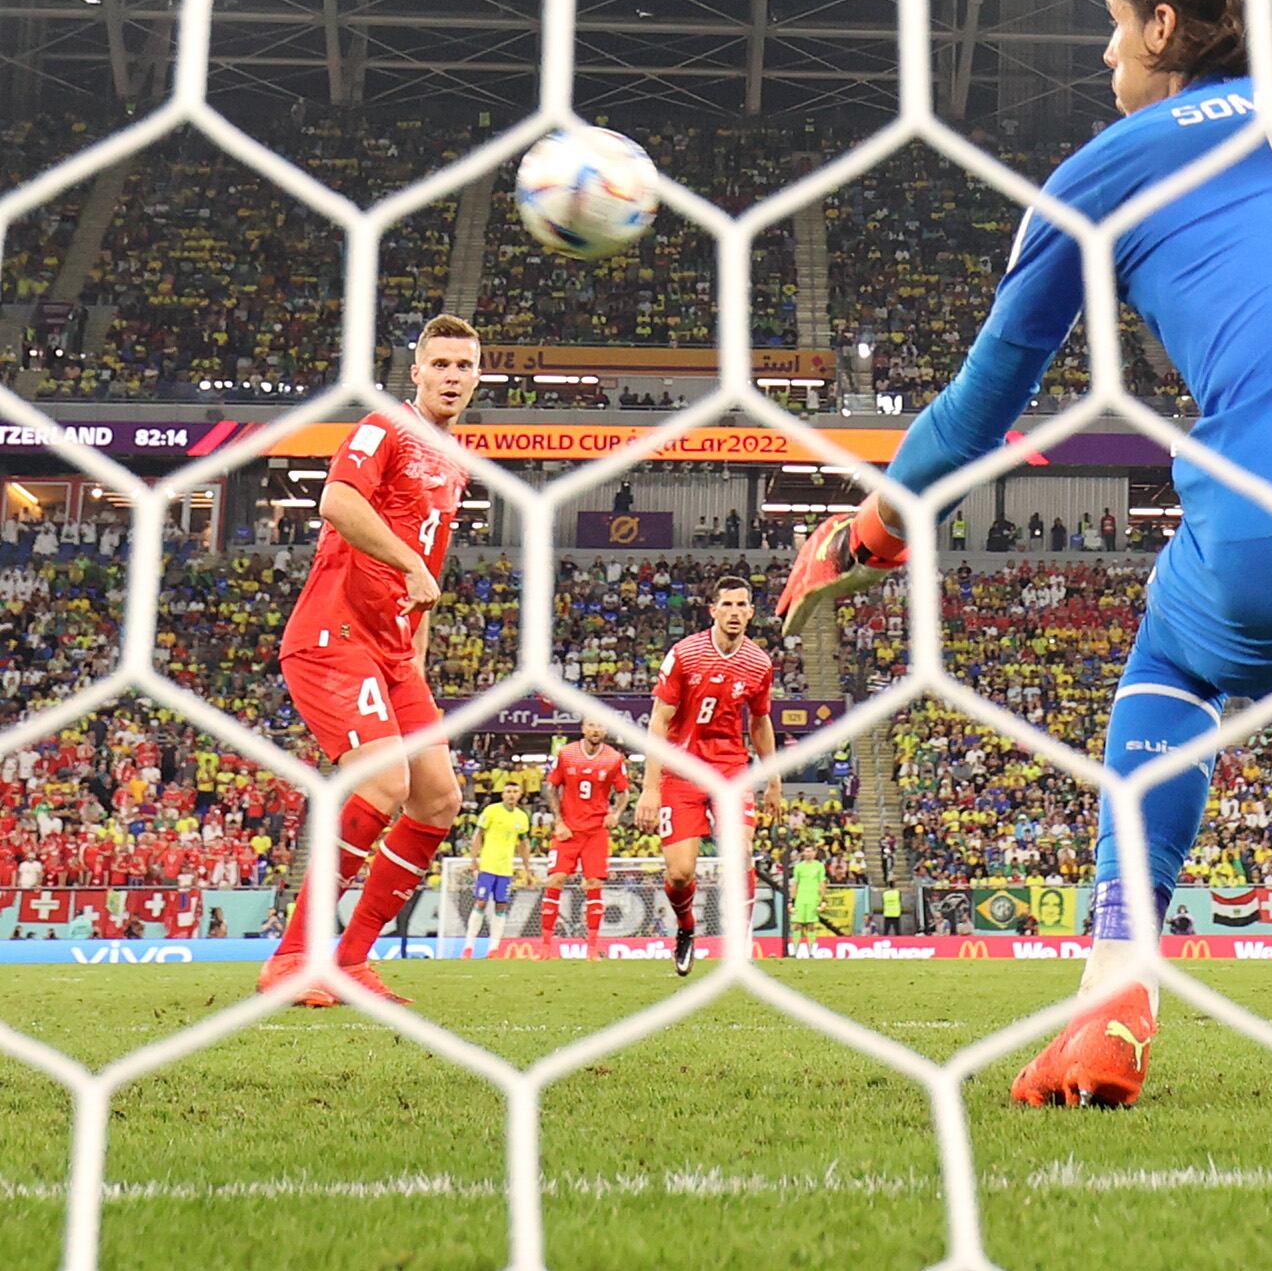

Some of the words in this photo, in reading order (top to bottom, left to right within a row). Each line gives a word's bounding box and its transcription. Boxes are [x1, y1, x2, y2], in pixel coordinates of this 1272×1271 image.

[135, 428, 188, 447] 82:14
[495, 433, 573, 450] WORLD
[579, 434, 621, 451] CUP
[419, 508, 441, 556] 4
[357, 676, 389, 721] 4
[696, 697, 717, 724] 8
[578, 780, 591, 799] 9
[659, 805, 673, 838] 8
[71, 941, 192, 964] vivo
[836, 939, 935, 959] Deliver
[1012, 941, 1057, 959] We
